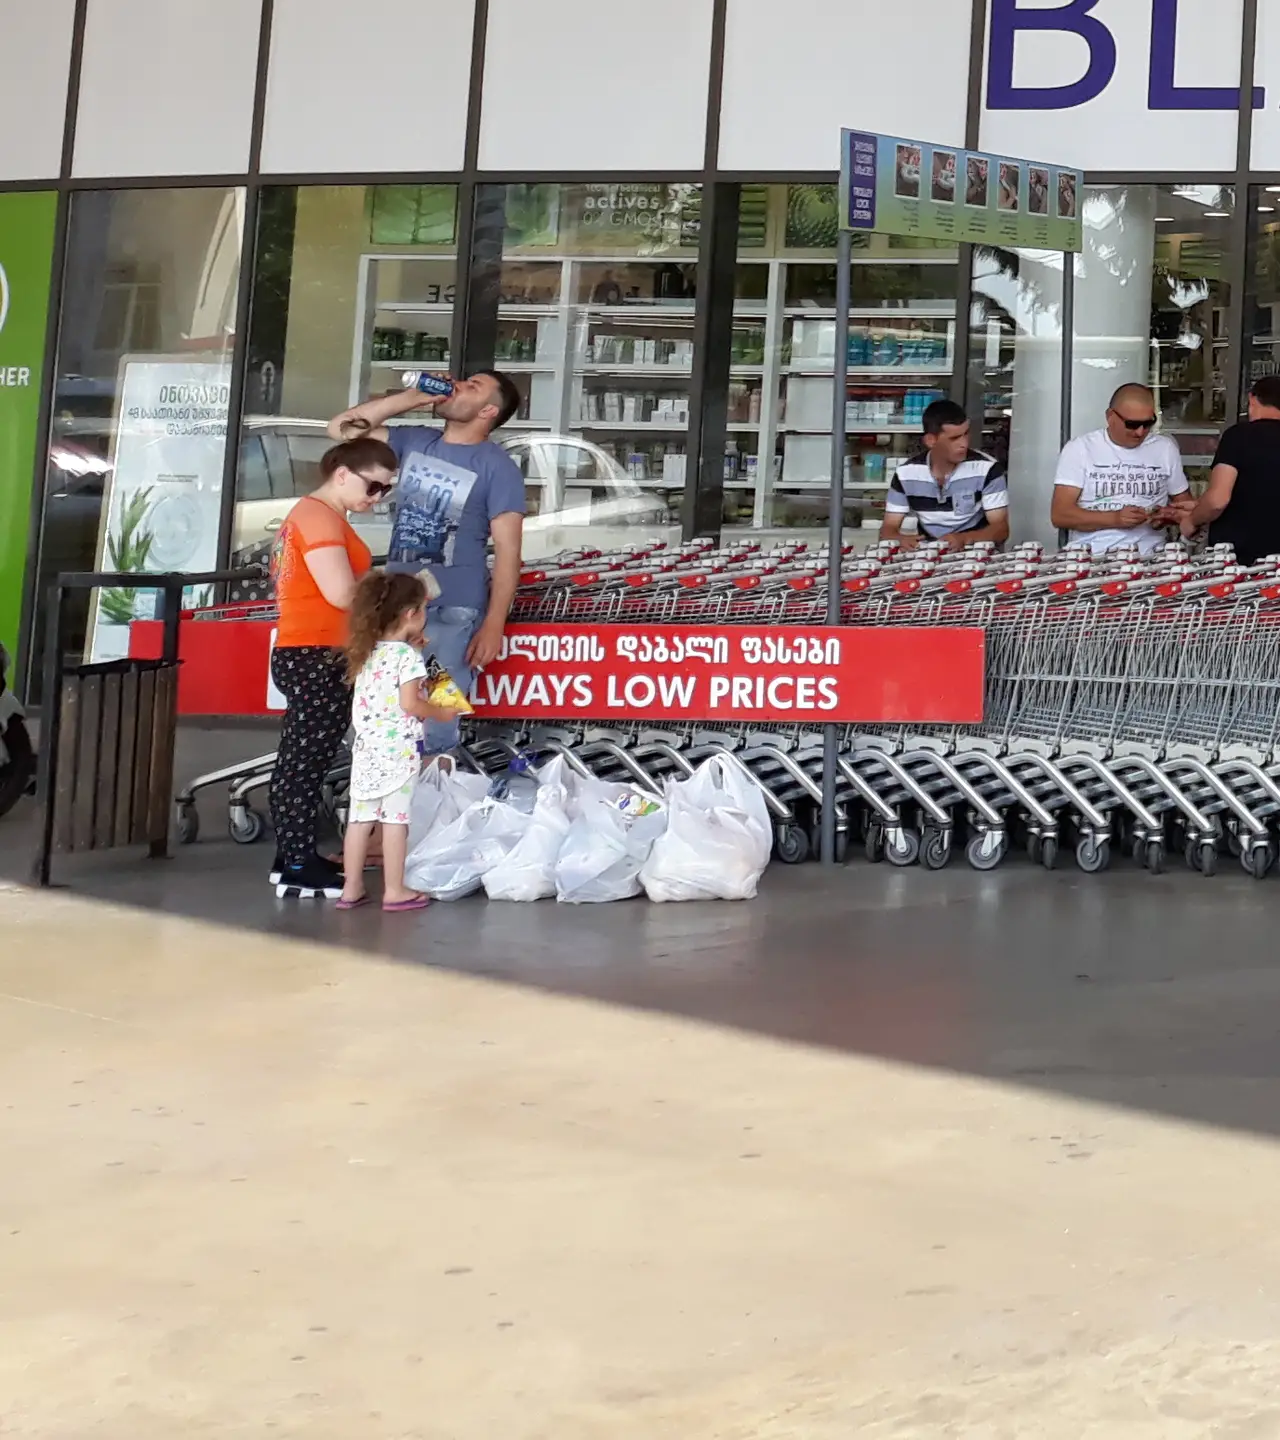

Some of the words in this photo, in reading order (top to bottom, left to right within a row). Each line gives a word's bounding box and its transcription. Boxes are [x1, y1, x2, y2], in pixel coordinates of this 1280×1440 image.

[424, 377, 446, 392] EFES
[616, 635, 728, 664] დაბალი
[742, 637, 840, 665] ფასები
[469, 673, 592, 707] LWAYS
[607, 675, 696, 709] LOW
[709, 677, 839, 710] PRICES
